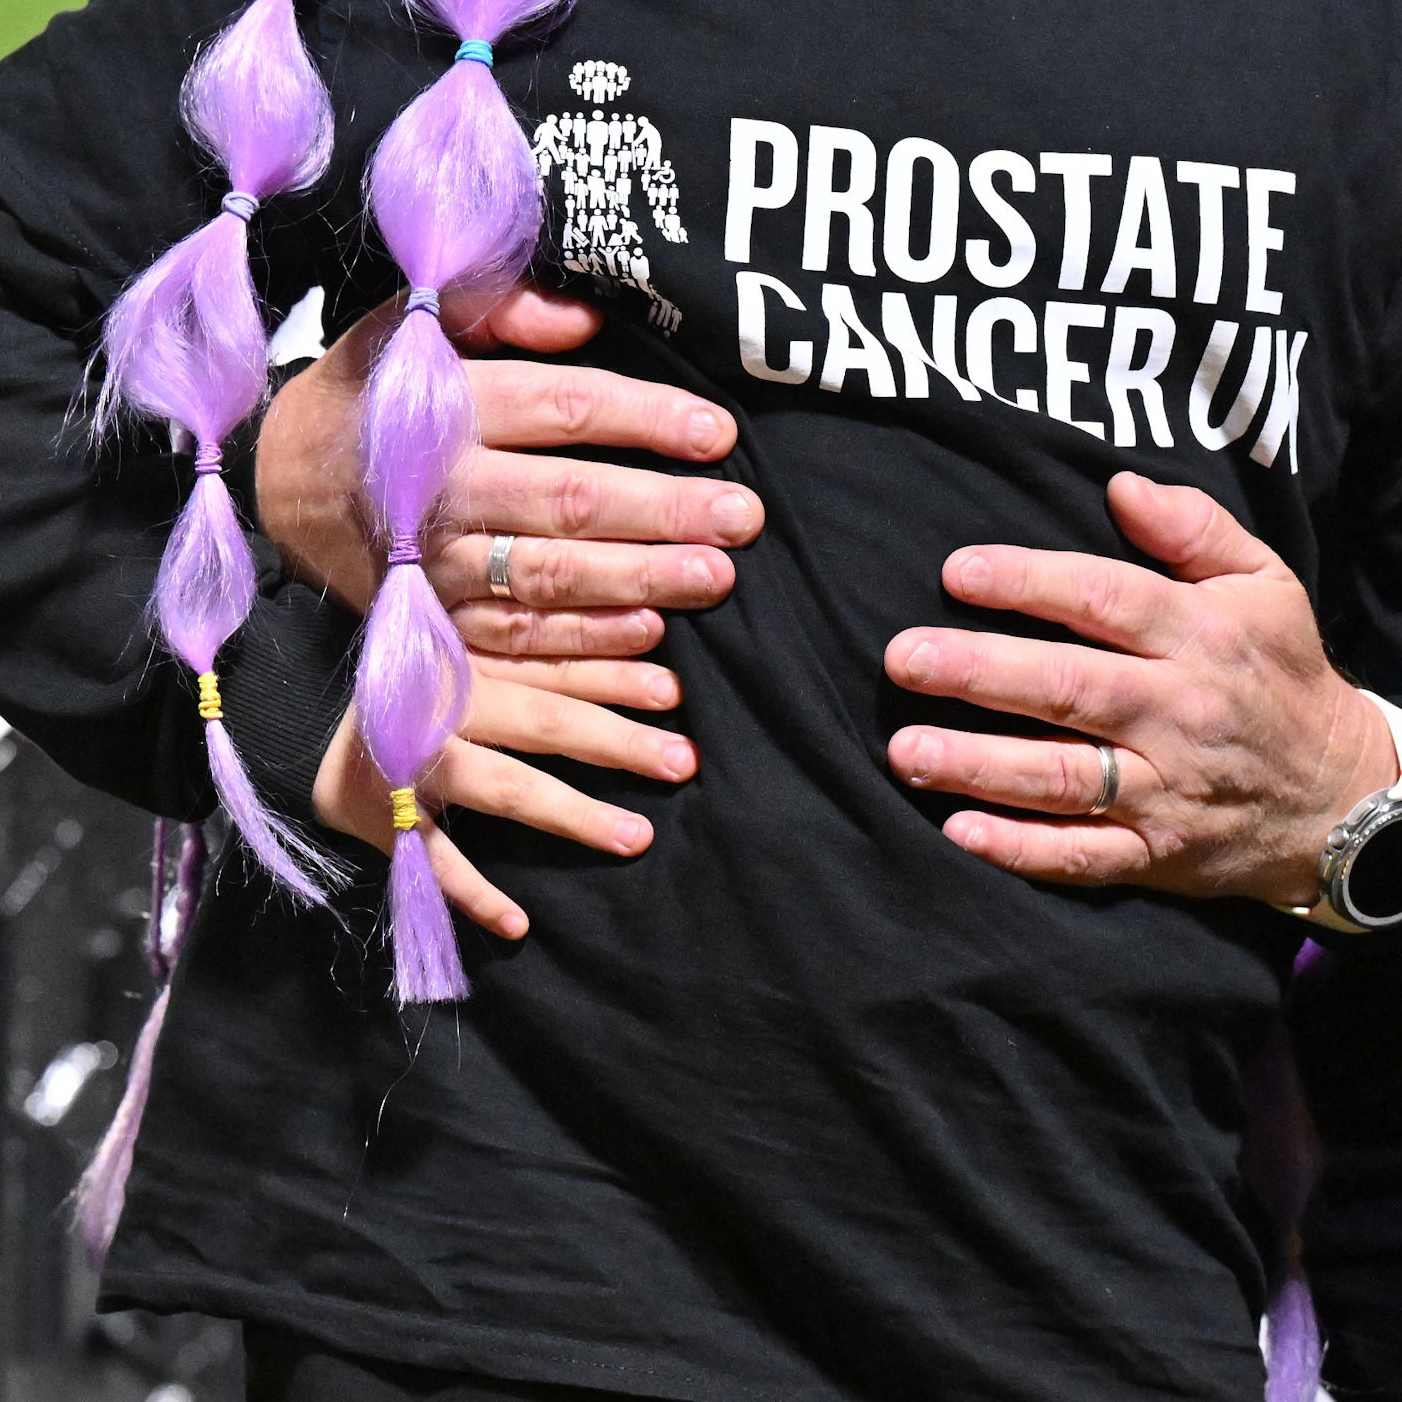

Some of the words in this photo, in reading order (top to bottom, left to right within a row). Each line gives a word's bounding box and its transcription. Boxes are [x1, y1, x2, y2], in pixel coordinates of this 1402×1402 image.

[724, 117, 1297, 316] PROSTATE
[735, 270, 1177, 448] CANCER
[1188, 319, 1309, 475] UK
